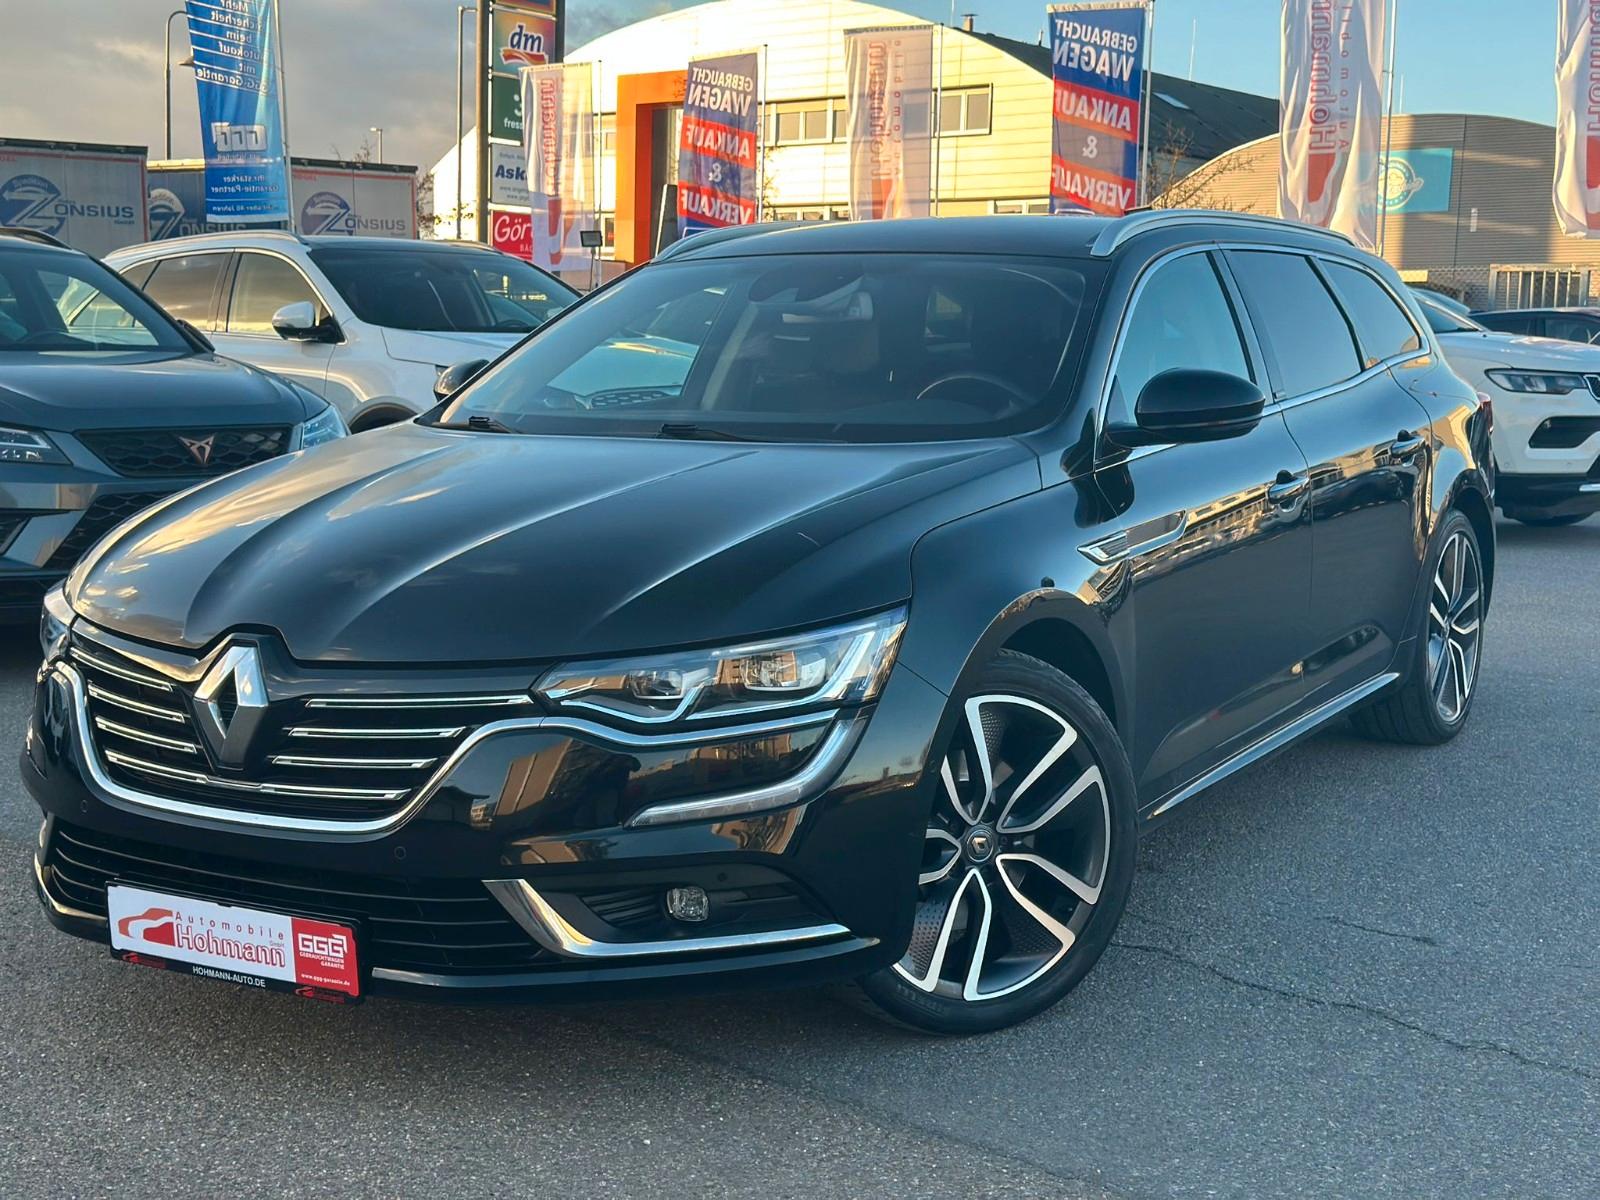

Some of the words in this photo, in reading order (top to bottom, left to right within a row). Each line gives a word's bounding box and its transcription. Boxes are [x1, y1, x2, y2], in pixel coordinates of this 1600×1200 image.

[510, 24, 542, 53] dm
[495, 164, 527, 181] Ask
[494, 215, 533, 243] Gör
[175, 911, 285, 941] Automobile
[176, 923, 287, 968] Hohmann
[298, 932, 345, 958] GGG
[192, 965, 267, 988] HOHMANN-AUTO.DE
